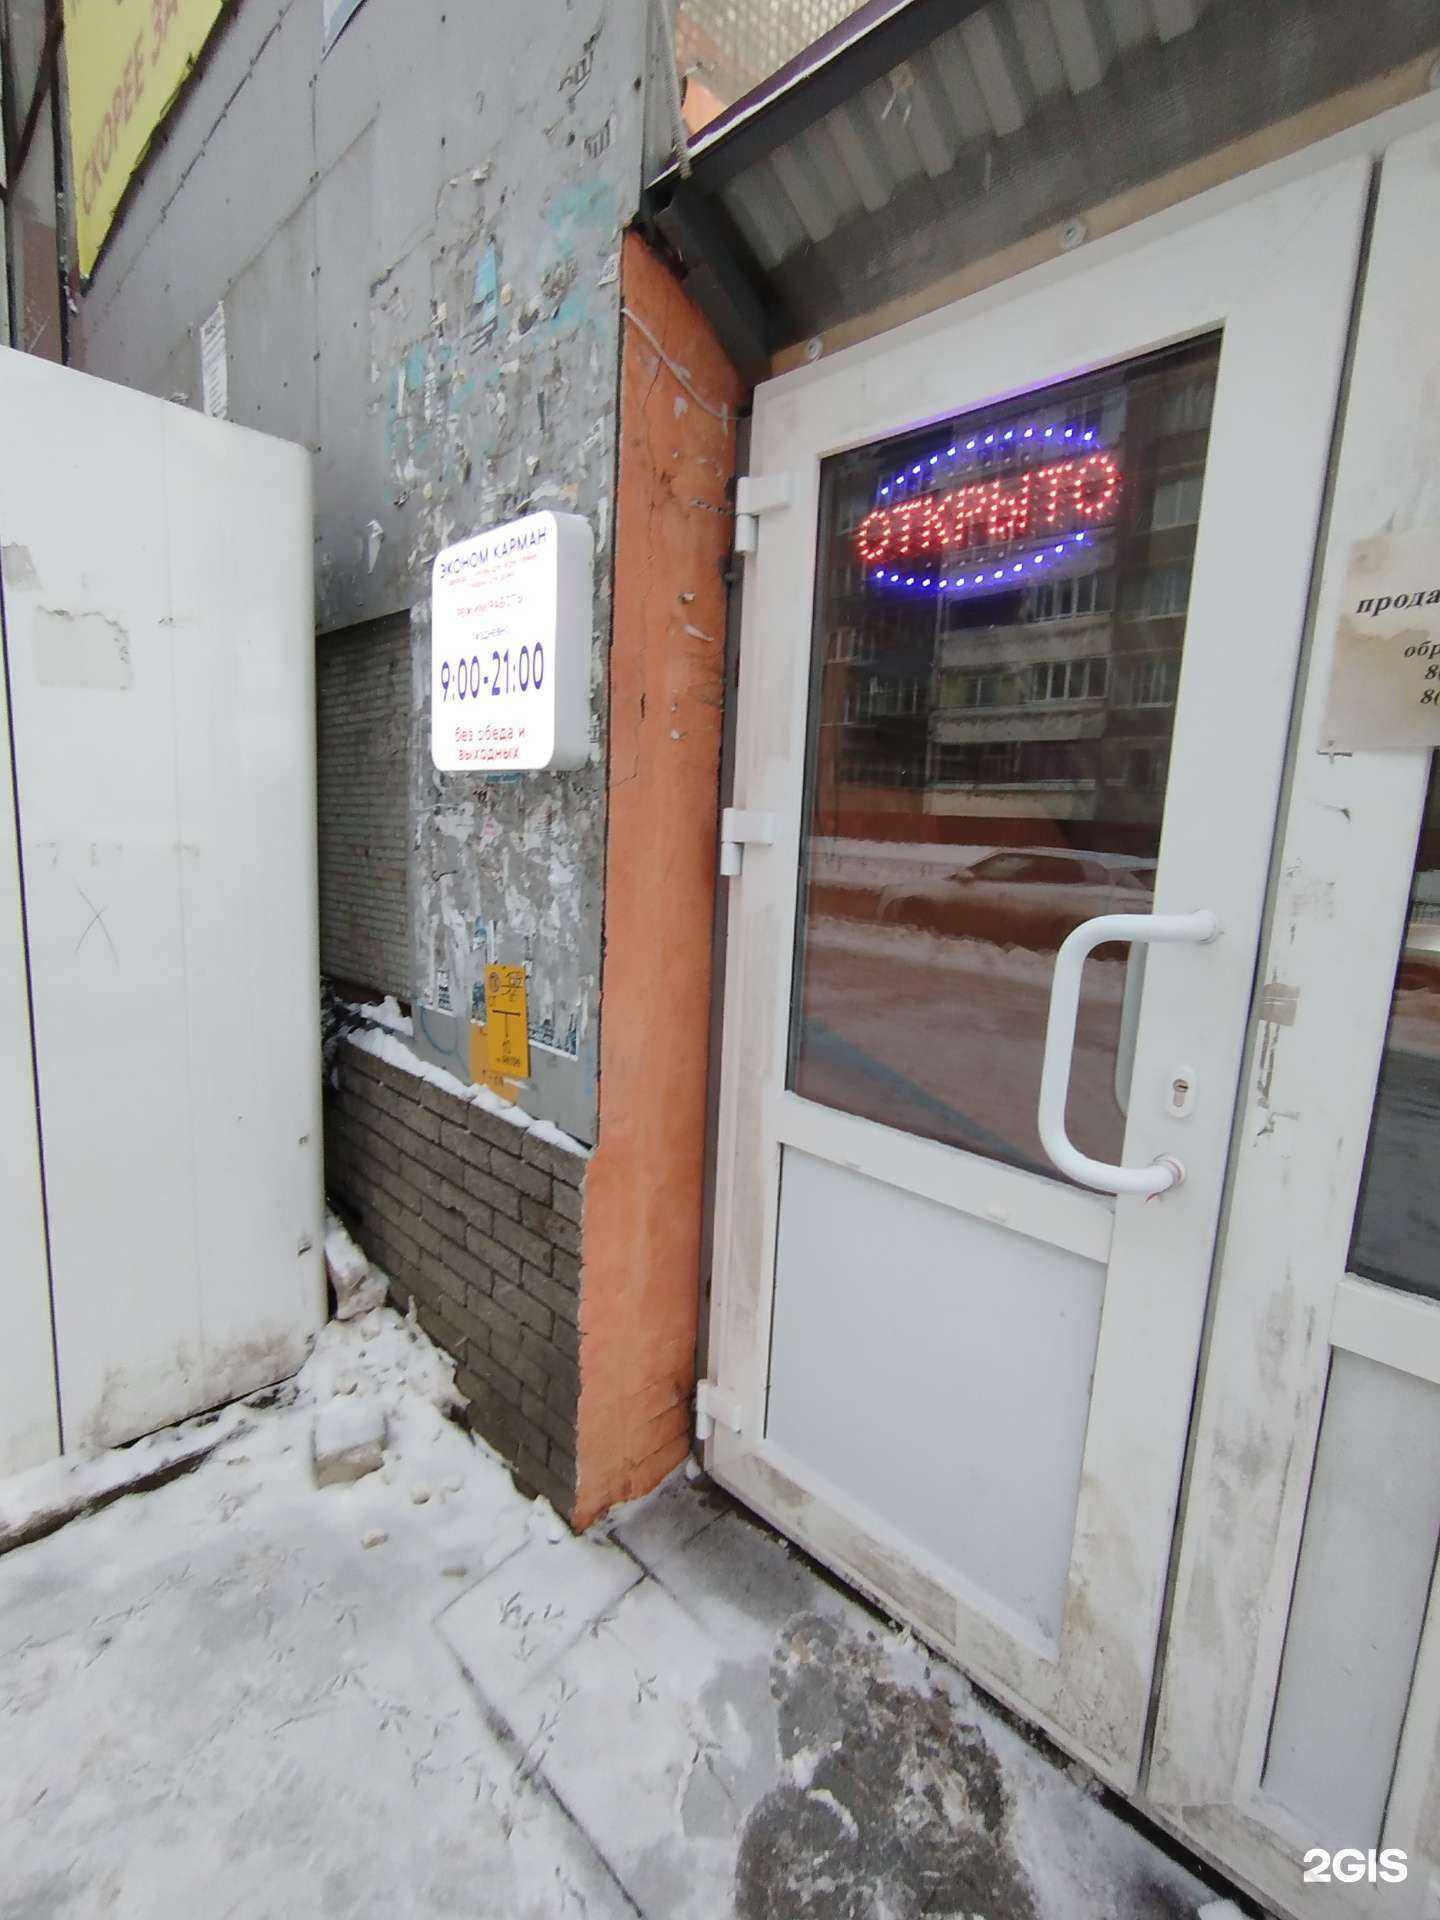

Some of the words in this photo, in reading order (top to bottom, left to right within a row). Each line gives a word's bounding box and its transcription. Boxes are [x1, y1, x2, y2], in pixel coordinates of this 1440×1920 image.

[82, 28, 144, 214] СКОРЕЕ
[857, 453, 1122, 560] ОТКРЫТО
[440, 546, 489, 579] ЭКОНОМ
[494, 527, 547, 559] КАРМАН
[440, 641, 545, 703] 9:00-21:00
[455, 726, 474, 743] без
[459, 747, 521, 761] выходных
